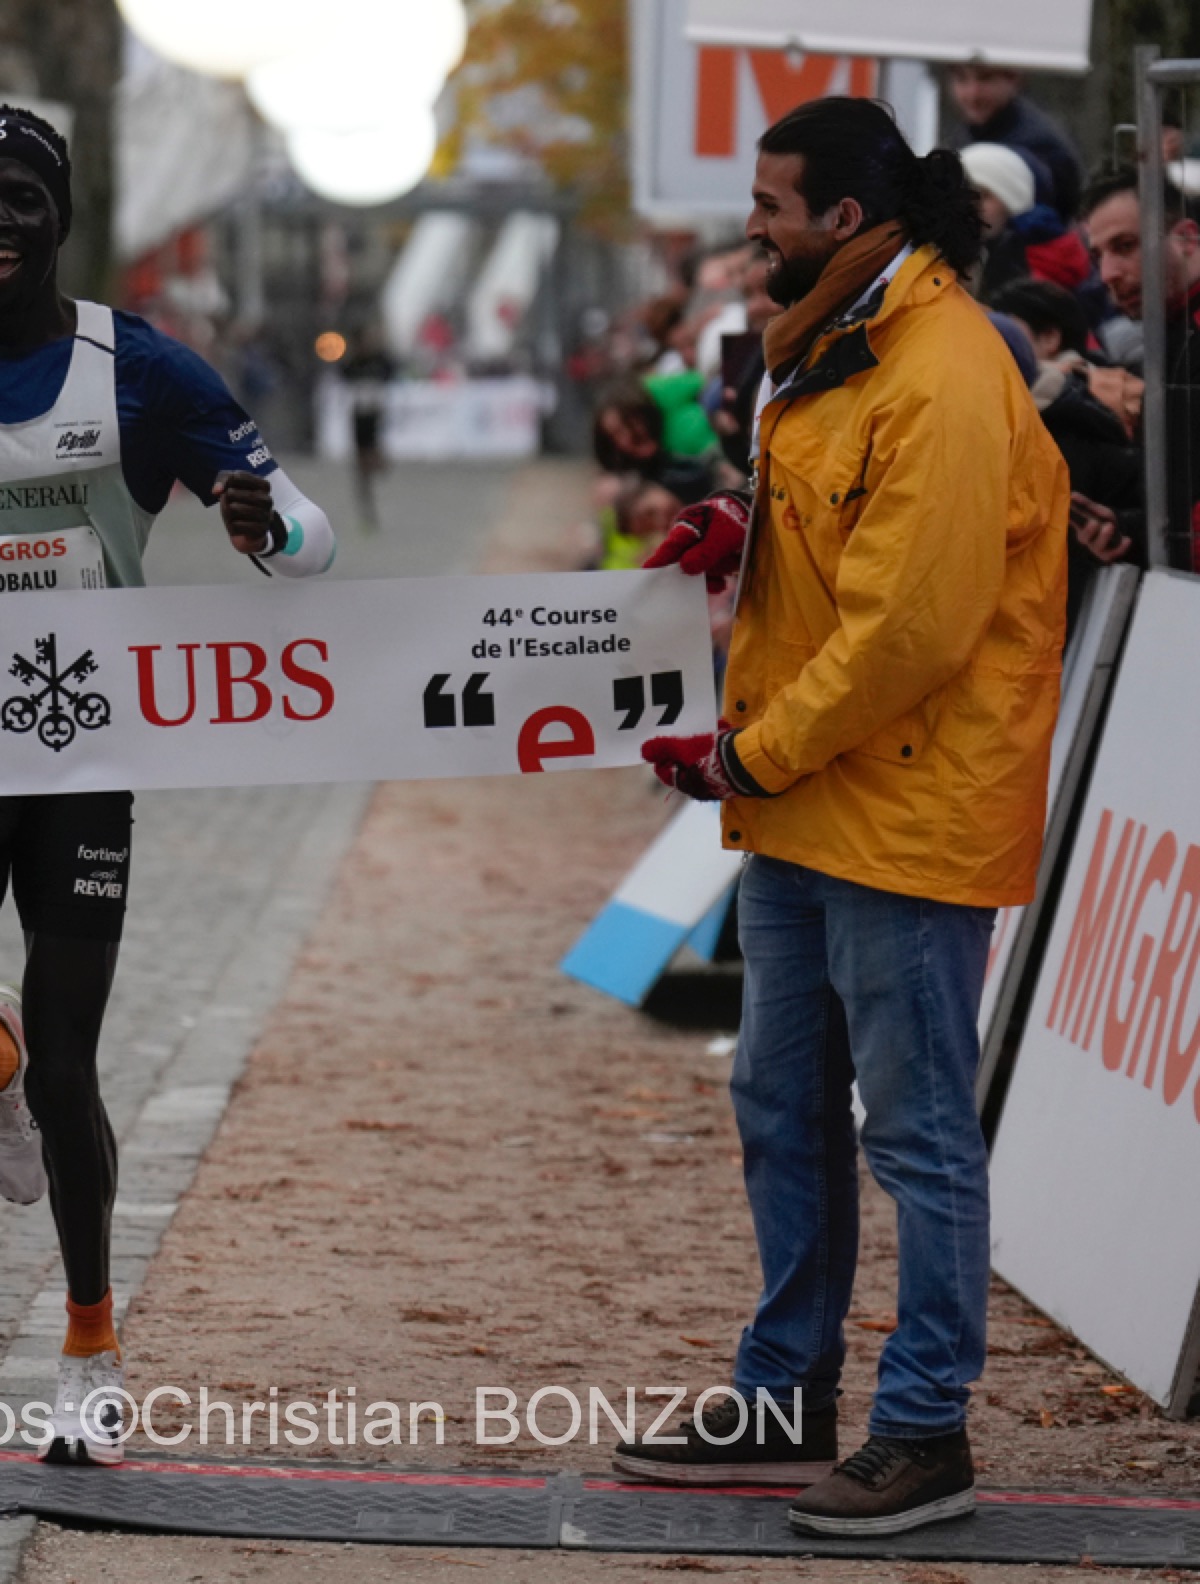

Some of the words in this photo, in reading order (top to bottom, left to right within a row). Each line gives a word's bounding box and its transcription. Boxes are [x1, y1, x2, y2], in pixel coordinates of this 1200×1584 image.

[471, 638, 503, 659] de
[509, 633, 631, 658] l’Escalade
[530, 606, 618, 628] Course
[127, 638, 336, 728] UBS
[1046, 808, 1200, 1124] MIGRO
